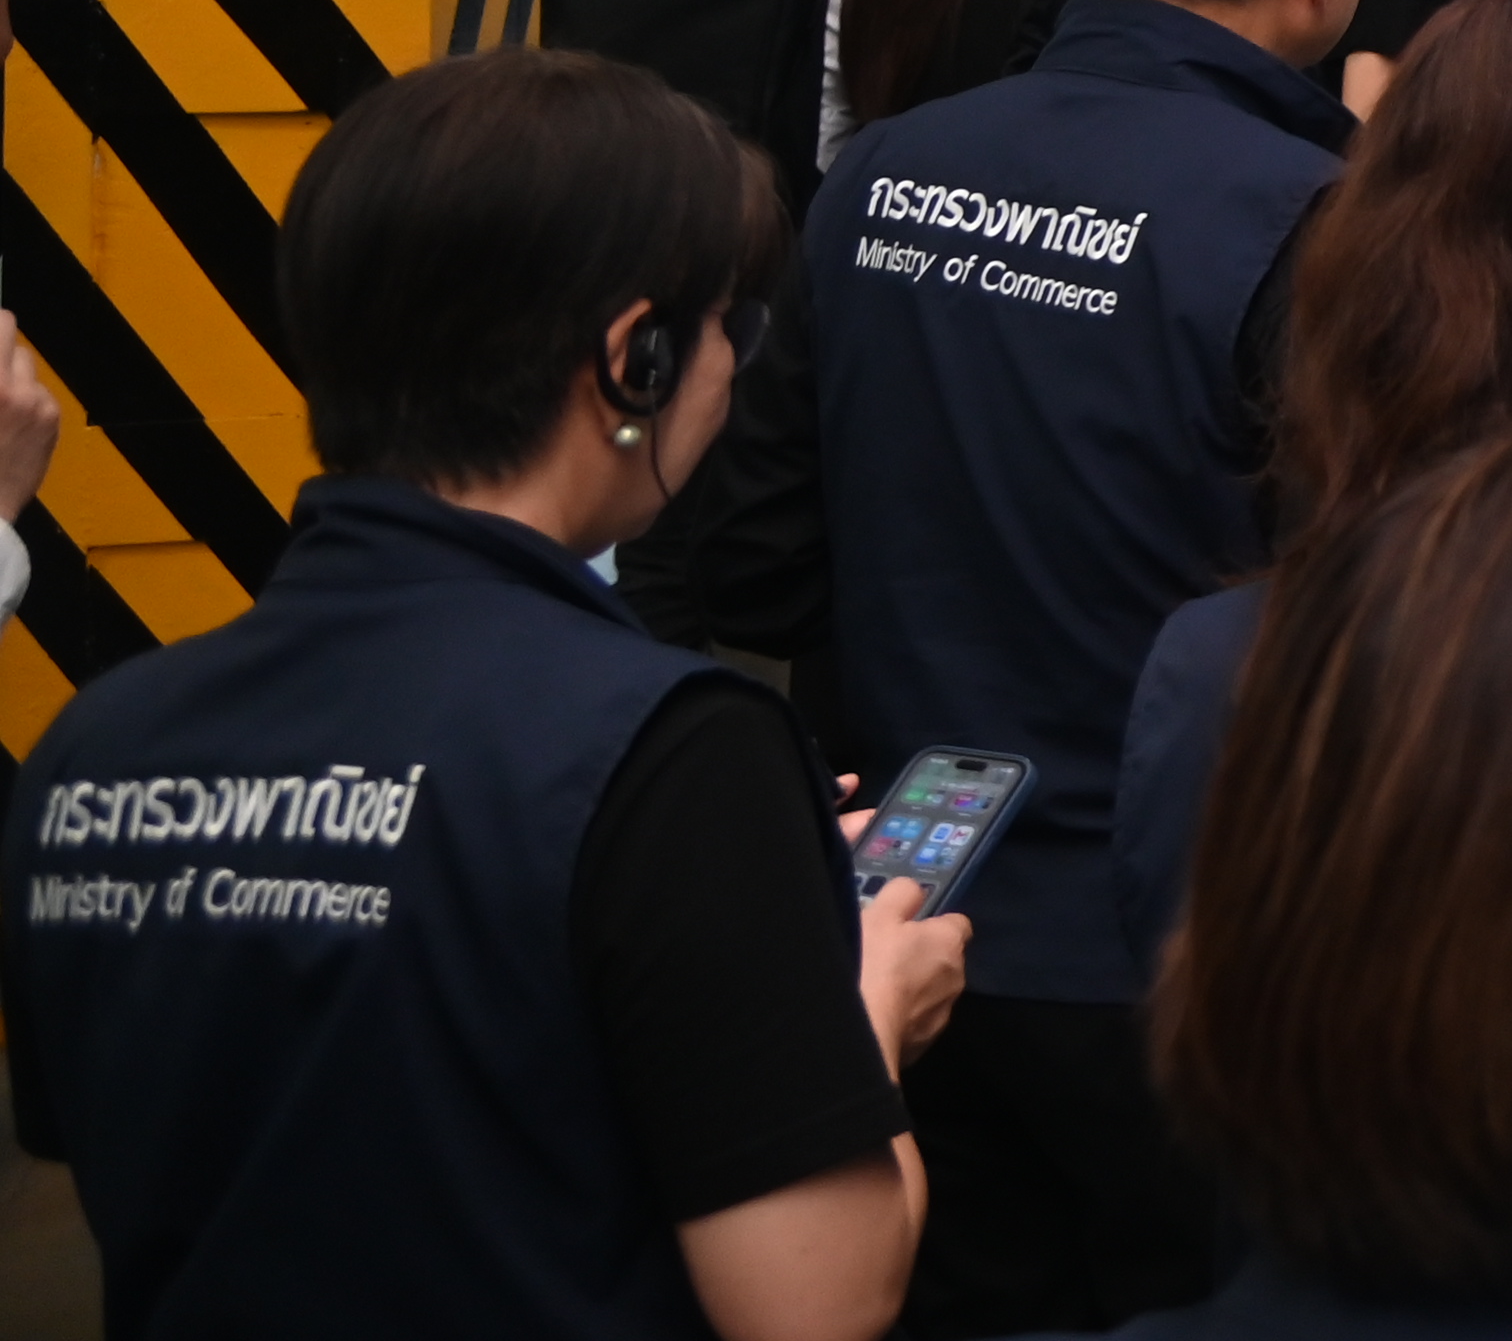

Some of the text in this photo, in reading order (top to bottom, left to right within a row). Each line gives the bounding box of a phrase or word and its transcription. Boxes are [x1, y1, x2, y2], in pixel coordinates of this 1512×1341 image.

[867, 177, 1148, 264] กระทรวงพาณิชย์
[856, 236, 1118, 315] Ministry of Commerce
[40, 764, 426, 848] กระทรวงพาณิชย์
[29, 866, 391, 935] Ministry of Commerce
